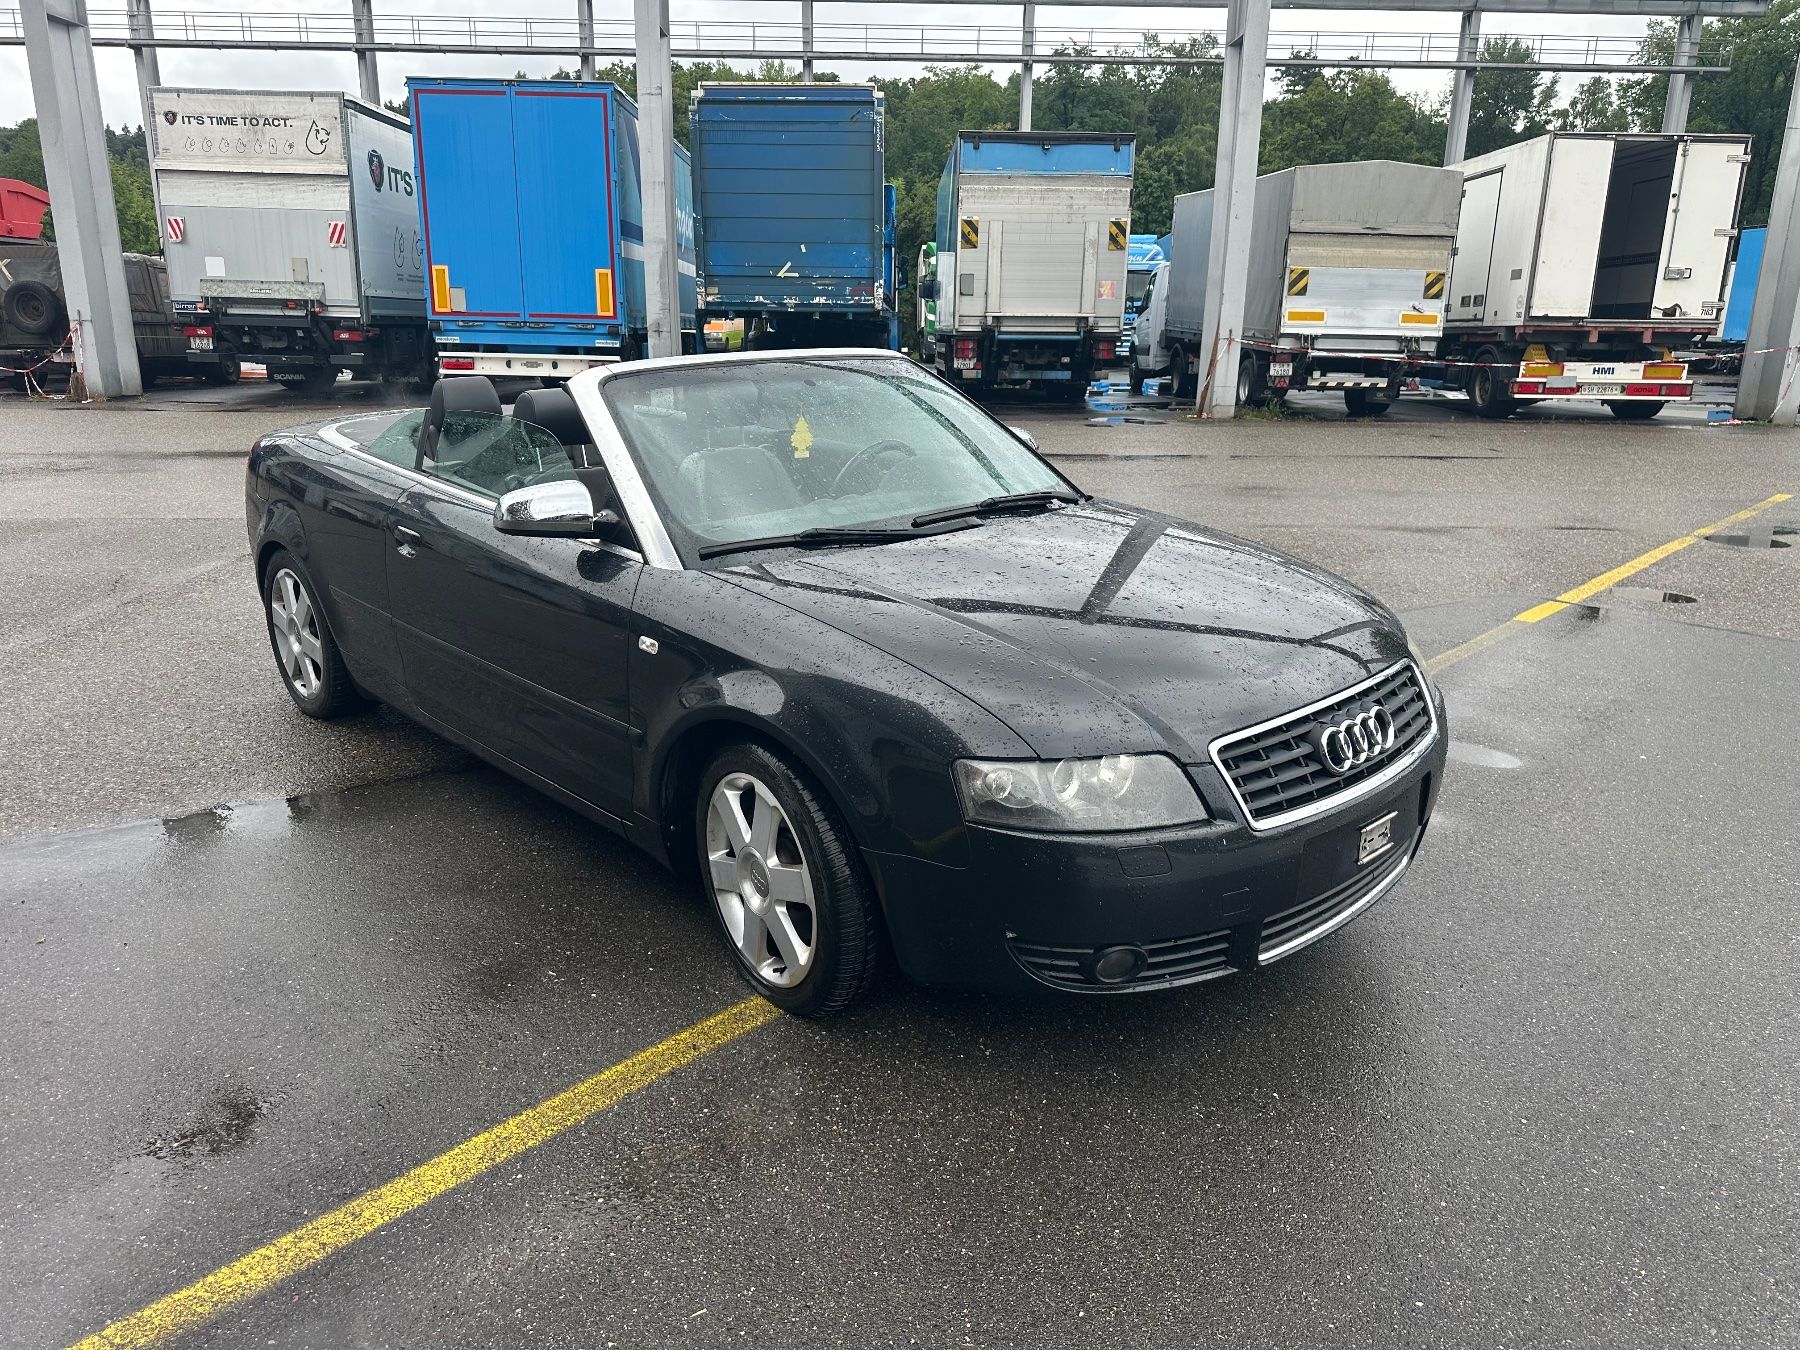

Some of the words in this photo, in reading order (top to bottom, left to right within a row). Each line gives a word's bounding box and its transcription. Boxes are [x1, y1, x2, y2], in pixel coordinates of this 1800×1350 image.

[181, 115, 205, 126] IT'S
[206, 115, 239, 127] TIME
[240, 116, 260, 127] TO
[262, 117, 294, 128] ACT.
[387, 165, 414, 197] IT'S
[1591, 366, 1615, 375] HMI
[273, 373, 306, 381] SCANIA
